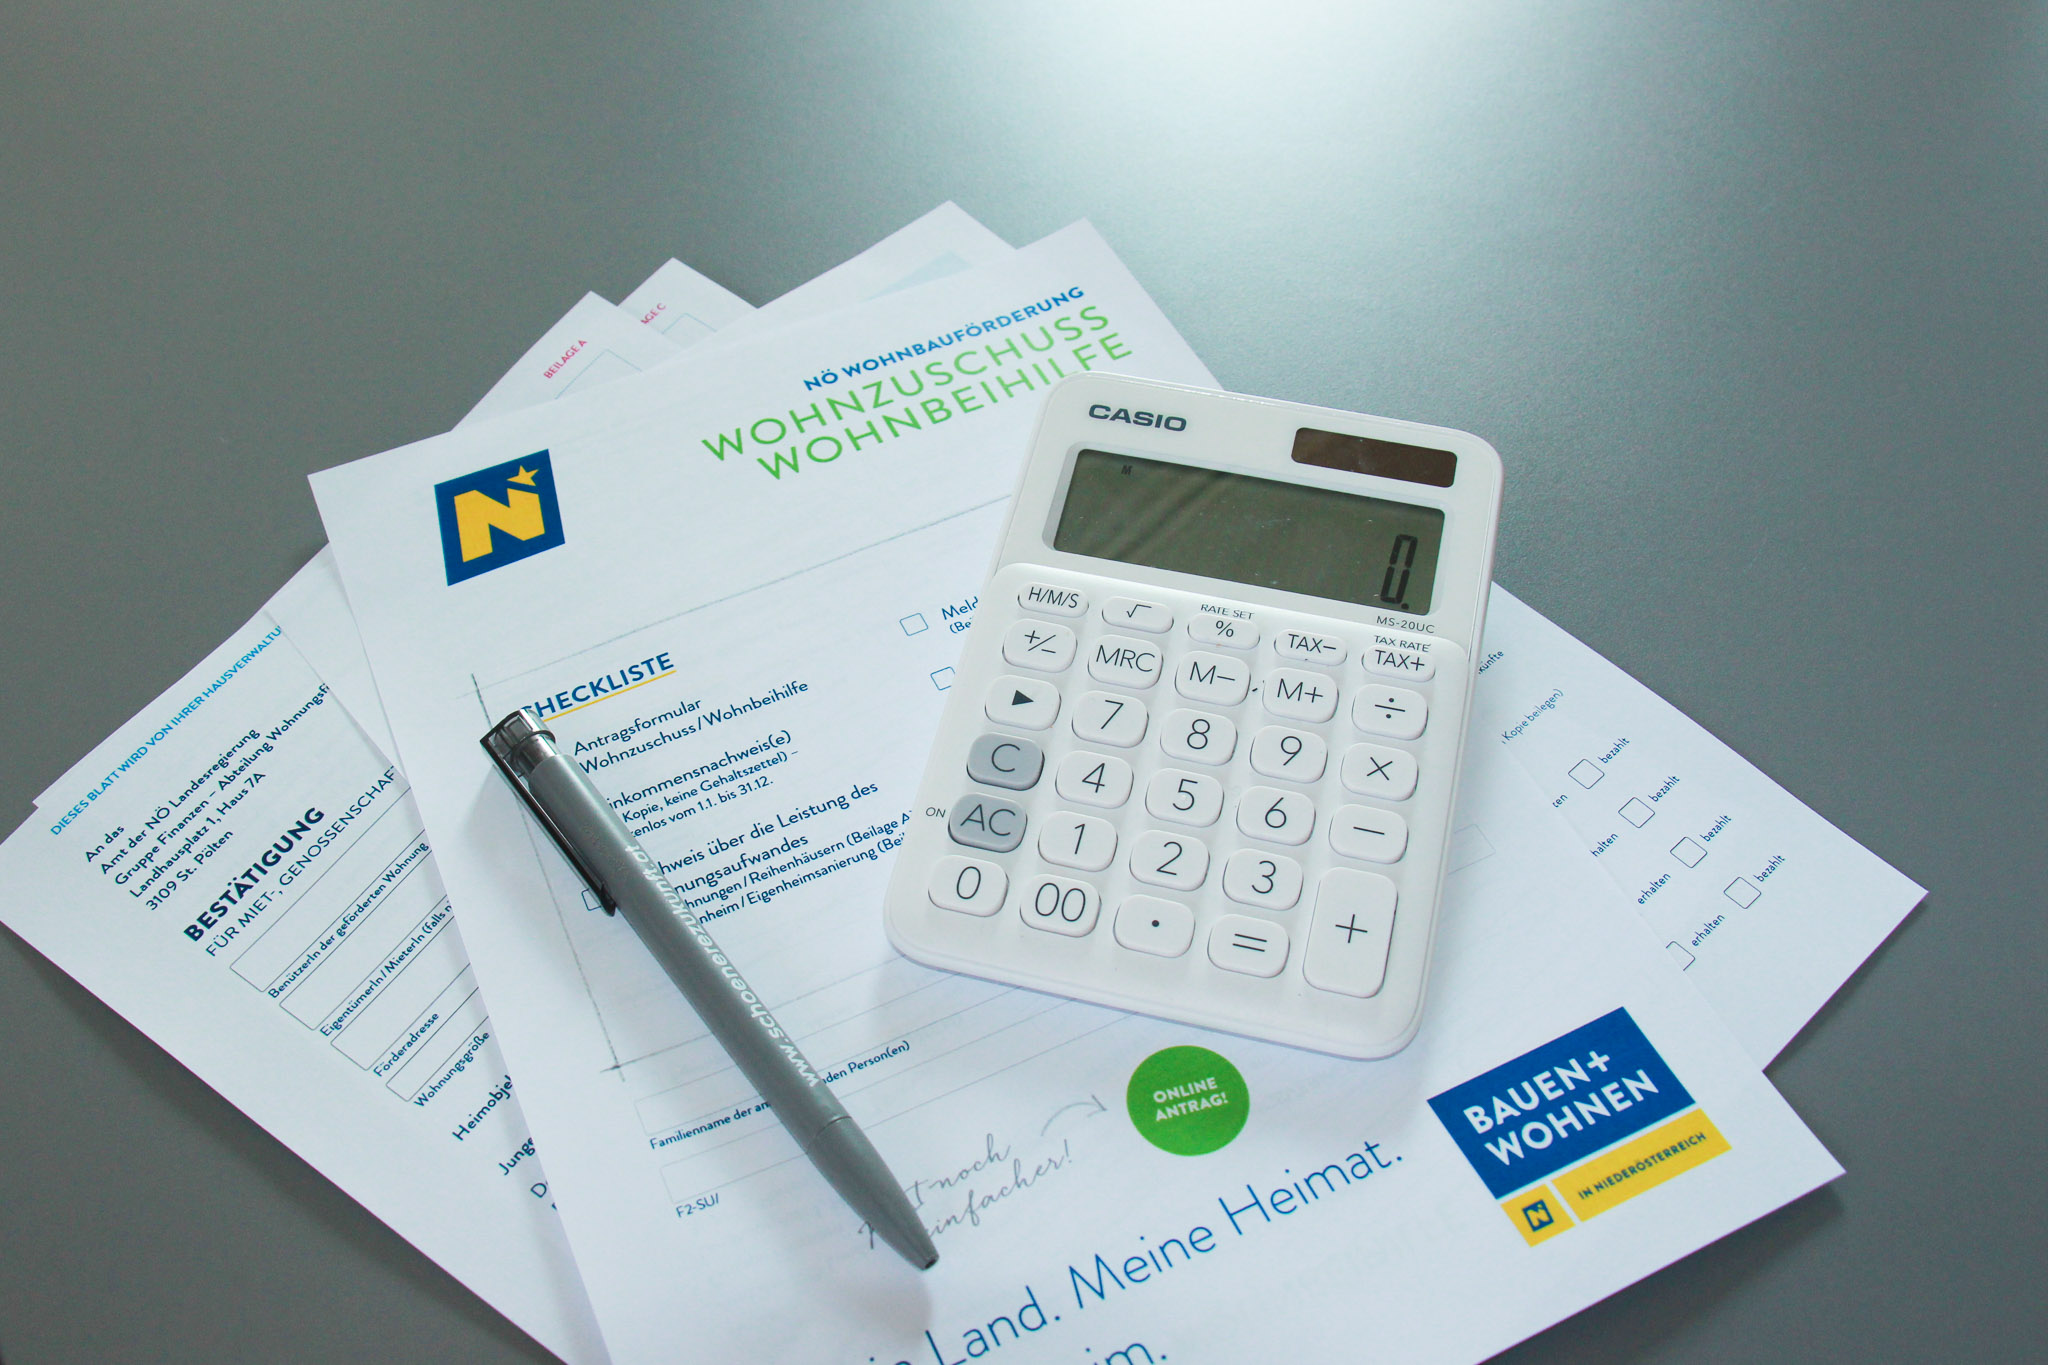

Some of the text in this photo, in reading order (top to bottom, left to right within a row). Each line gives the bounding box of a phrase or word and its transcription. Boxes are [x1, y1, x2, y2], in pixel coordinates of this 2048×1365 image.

[803, 285, 1085, 392] NÖ WOHNBAUFÖRDERUNG
[544, 339, 588, 379] BEILAGE A
[701, 305, 1110, 463] WOHNZUSCHUSS
[756, 332, 1133, 482] WOHNBEIHILFE
[1088, 404, 1187, 432] CASIO
[1028, 587, 1079, 609] H/M/S
[1201, 604, 1255, 620] RATE SET
[1376, 615, 1435, 634] MS-20UC
[1096, 644, 1156, 672] MRC
[1374, 635, 1431, 653] TAX RATE
[1375, 649, 1425, 672] TAX+
[521, 653, 675, 718] HECKLISTE
[1276, 677, 1324, 703] M+
[1101, 700, 1124, 730] 7
[1523, 688, 1564, 722] beilegen)
[574, 700, 701, 756] Antragsformular
[580, 723, 696, 775] Wohnzuschuss
[703, 680, 809, 728] Wohnbeihilfe
[1187, 718, 1211, 750] 8
[51, 798, 90, 836] DIESES
[87, 772, 120, 803] BLATT
[117, 744, 149, 776] WIRD
[145, 723, 174, 750] VON
[169, 696, 205, 728] IHRER
[991, 742, 1021, 774] C
[1280, 736, 1302, 766] 9
[1598, 737, 1631, 765] bezahlt
[664, 787, 699, 807] keine
[699, 750, 789, 793] Gehaltszettel)
[1082, 763, 1105, 794] 4
[1173, 778, 1198, 811] 5
[1648, 775, 1681, 803] bezahlt
[100, 728, 261, 876] Amt der NÖ Landesregierung
[114, 844, 161, 887] Gruppe
[156, 800, 210, 848] Finanzen
[217, 740, 273, 793] Abteilung
[669, 807, 697, 823] vom
[697, 798, 717, 811] 1.1.
[718, 790, 738, 804] bis
[738, 777, 775, 800] 31.12.
[926, 807, 946, 819] ON
[1264, 797, 1287, 829] 6
[130, 770, 267, 900] Landhausplatz 1, Haus 7A
[707, 833, 745, 856] über
[750, 817, 776, 841] die
[776, 794, 850, 832] Leistung
[850, 780, 879, 807] des
[960, 804, 1017, 838] AC
[1700, 814, 1732, 843] bezahlt
[85, 824, 126, 863] An das
[748, 839, 847, 888] Reihenhäusern
[846, 820, 899, 847] (Beilage
[1073, 824, 1086, 855] 1
[145, 828, 235, 912] 3109 St. Pölten
[183, 805, 325, 943] BESTÄTIGUNG
[747, 847, 879, 906] Eigenheimsanierung
[1156, 842, 1182, 876] 2
[1754, 855, 1786, 883] bezahlt
[956, 866, 981, 900] 0
[1252, 860, 1277, 895] 3
[1637, 872, 1671, 905] erhalten
[318, 934, 338, 953] der
[335, 884, 386, 938] geförderten
[381, 842, 430, 883] Wohnung
[1034, 882, 1087, 923] 00
[206, 925, 240, 957] FÜR
[238, 888, 285, 929] MIET-,
[421, 911, 446, 935] (falls
[1691, 914, 1725, 947] erhalten
[373, 1012, 440, 1078] Förderadresse
[847, 1040, 910, 1075] Person(en)
[413, 1031, 490, 1109] Wohnungsgröße
[1152, 1077, 1218, 1104] ONLINE
[1154, 1091, 1229, 1122] ANTRAG!
[1463, 1050, 1610, 1134] BAUEN+
[650, 1115, 731, 1150] Familienname
[733, 1105, 753, 1121] der
[1484, 1069, 1659, 1166] WOHNEN
[928, 1133, 1010, 1189] noch
[1578, 1132, 1707, 1200] IN NIEDERÖSTERREICH
[925, 1140, 1403, 1365] Land. Meine Heimat.
